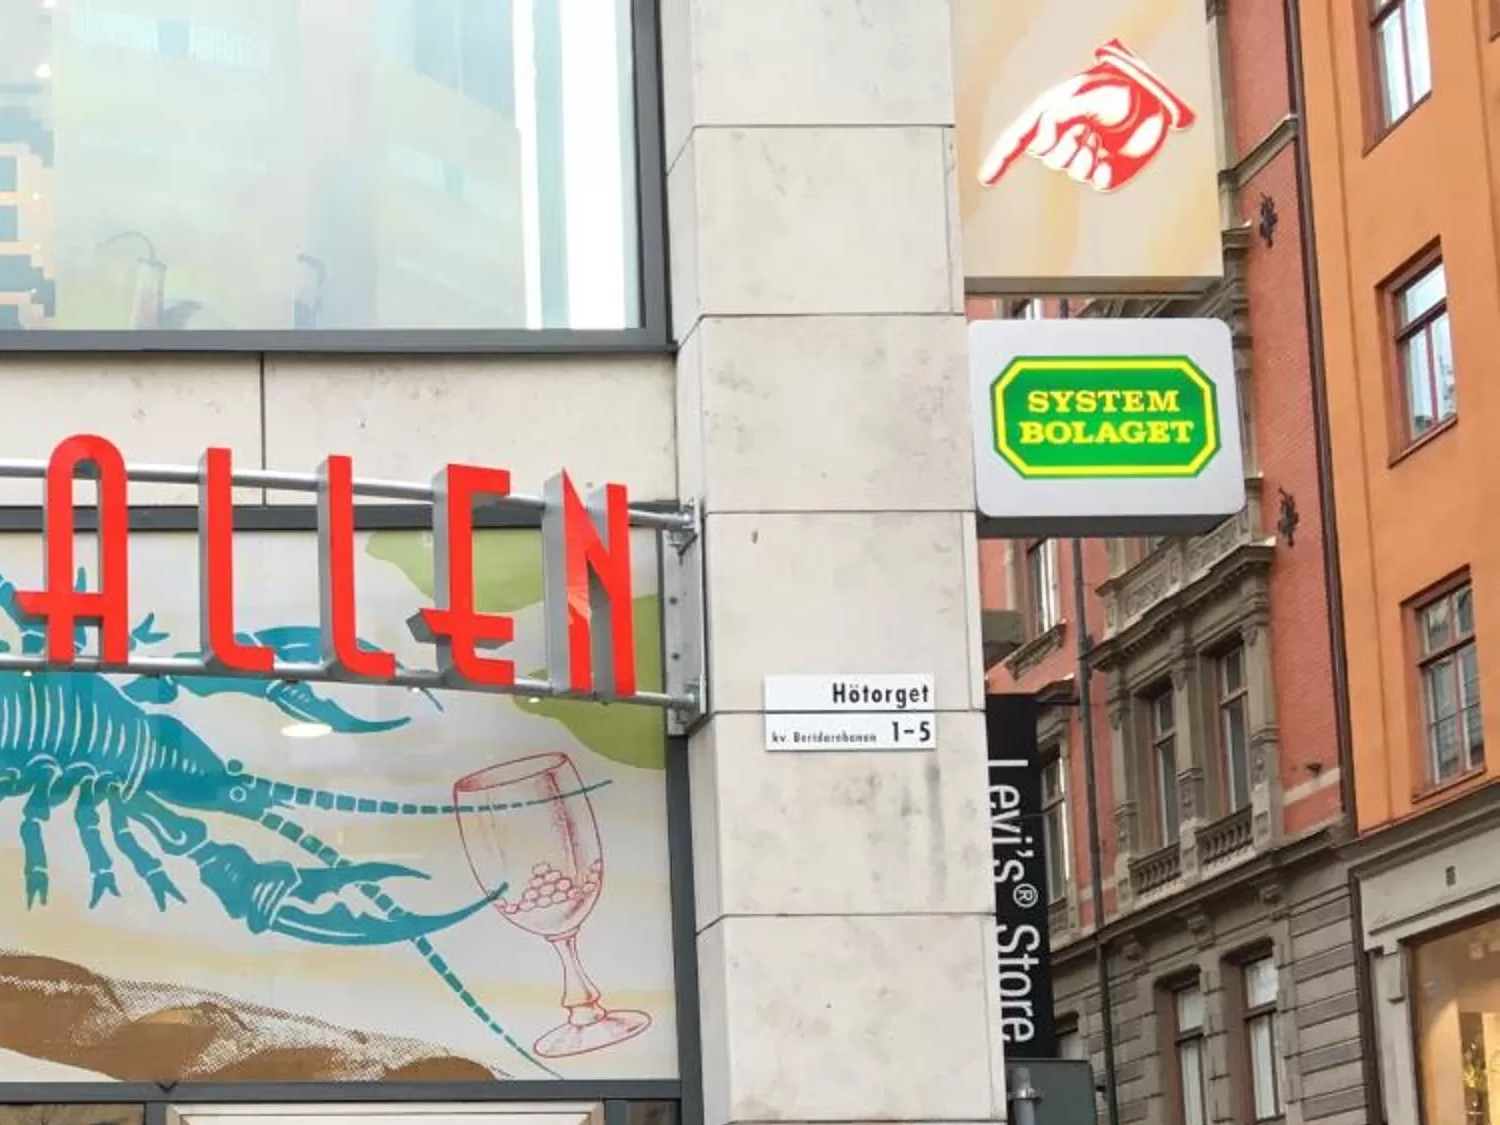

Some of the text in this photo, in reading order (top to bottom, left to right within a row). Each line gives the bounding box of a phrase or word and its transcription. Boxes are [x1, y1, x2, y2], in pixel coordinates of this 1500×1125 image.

[1027, 389, 1181, 414] SYSTEM
[1018, 420, 1195, 445] BOLAGET
[832, 682, 929, 709] Hötorget
[996, 924, 1041, 1043] Store
